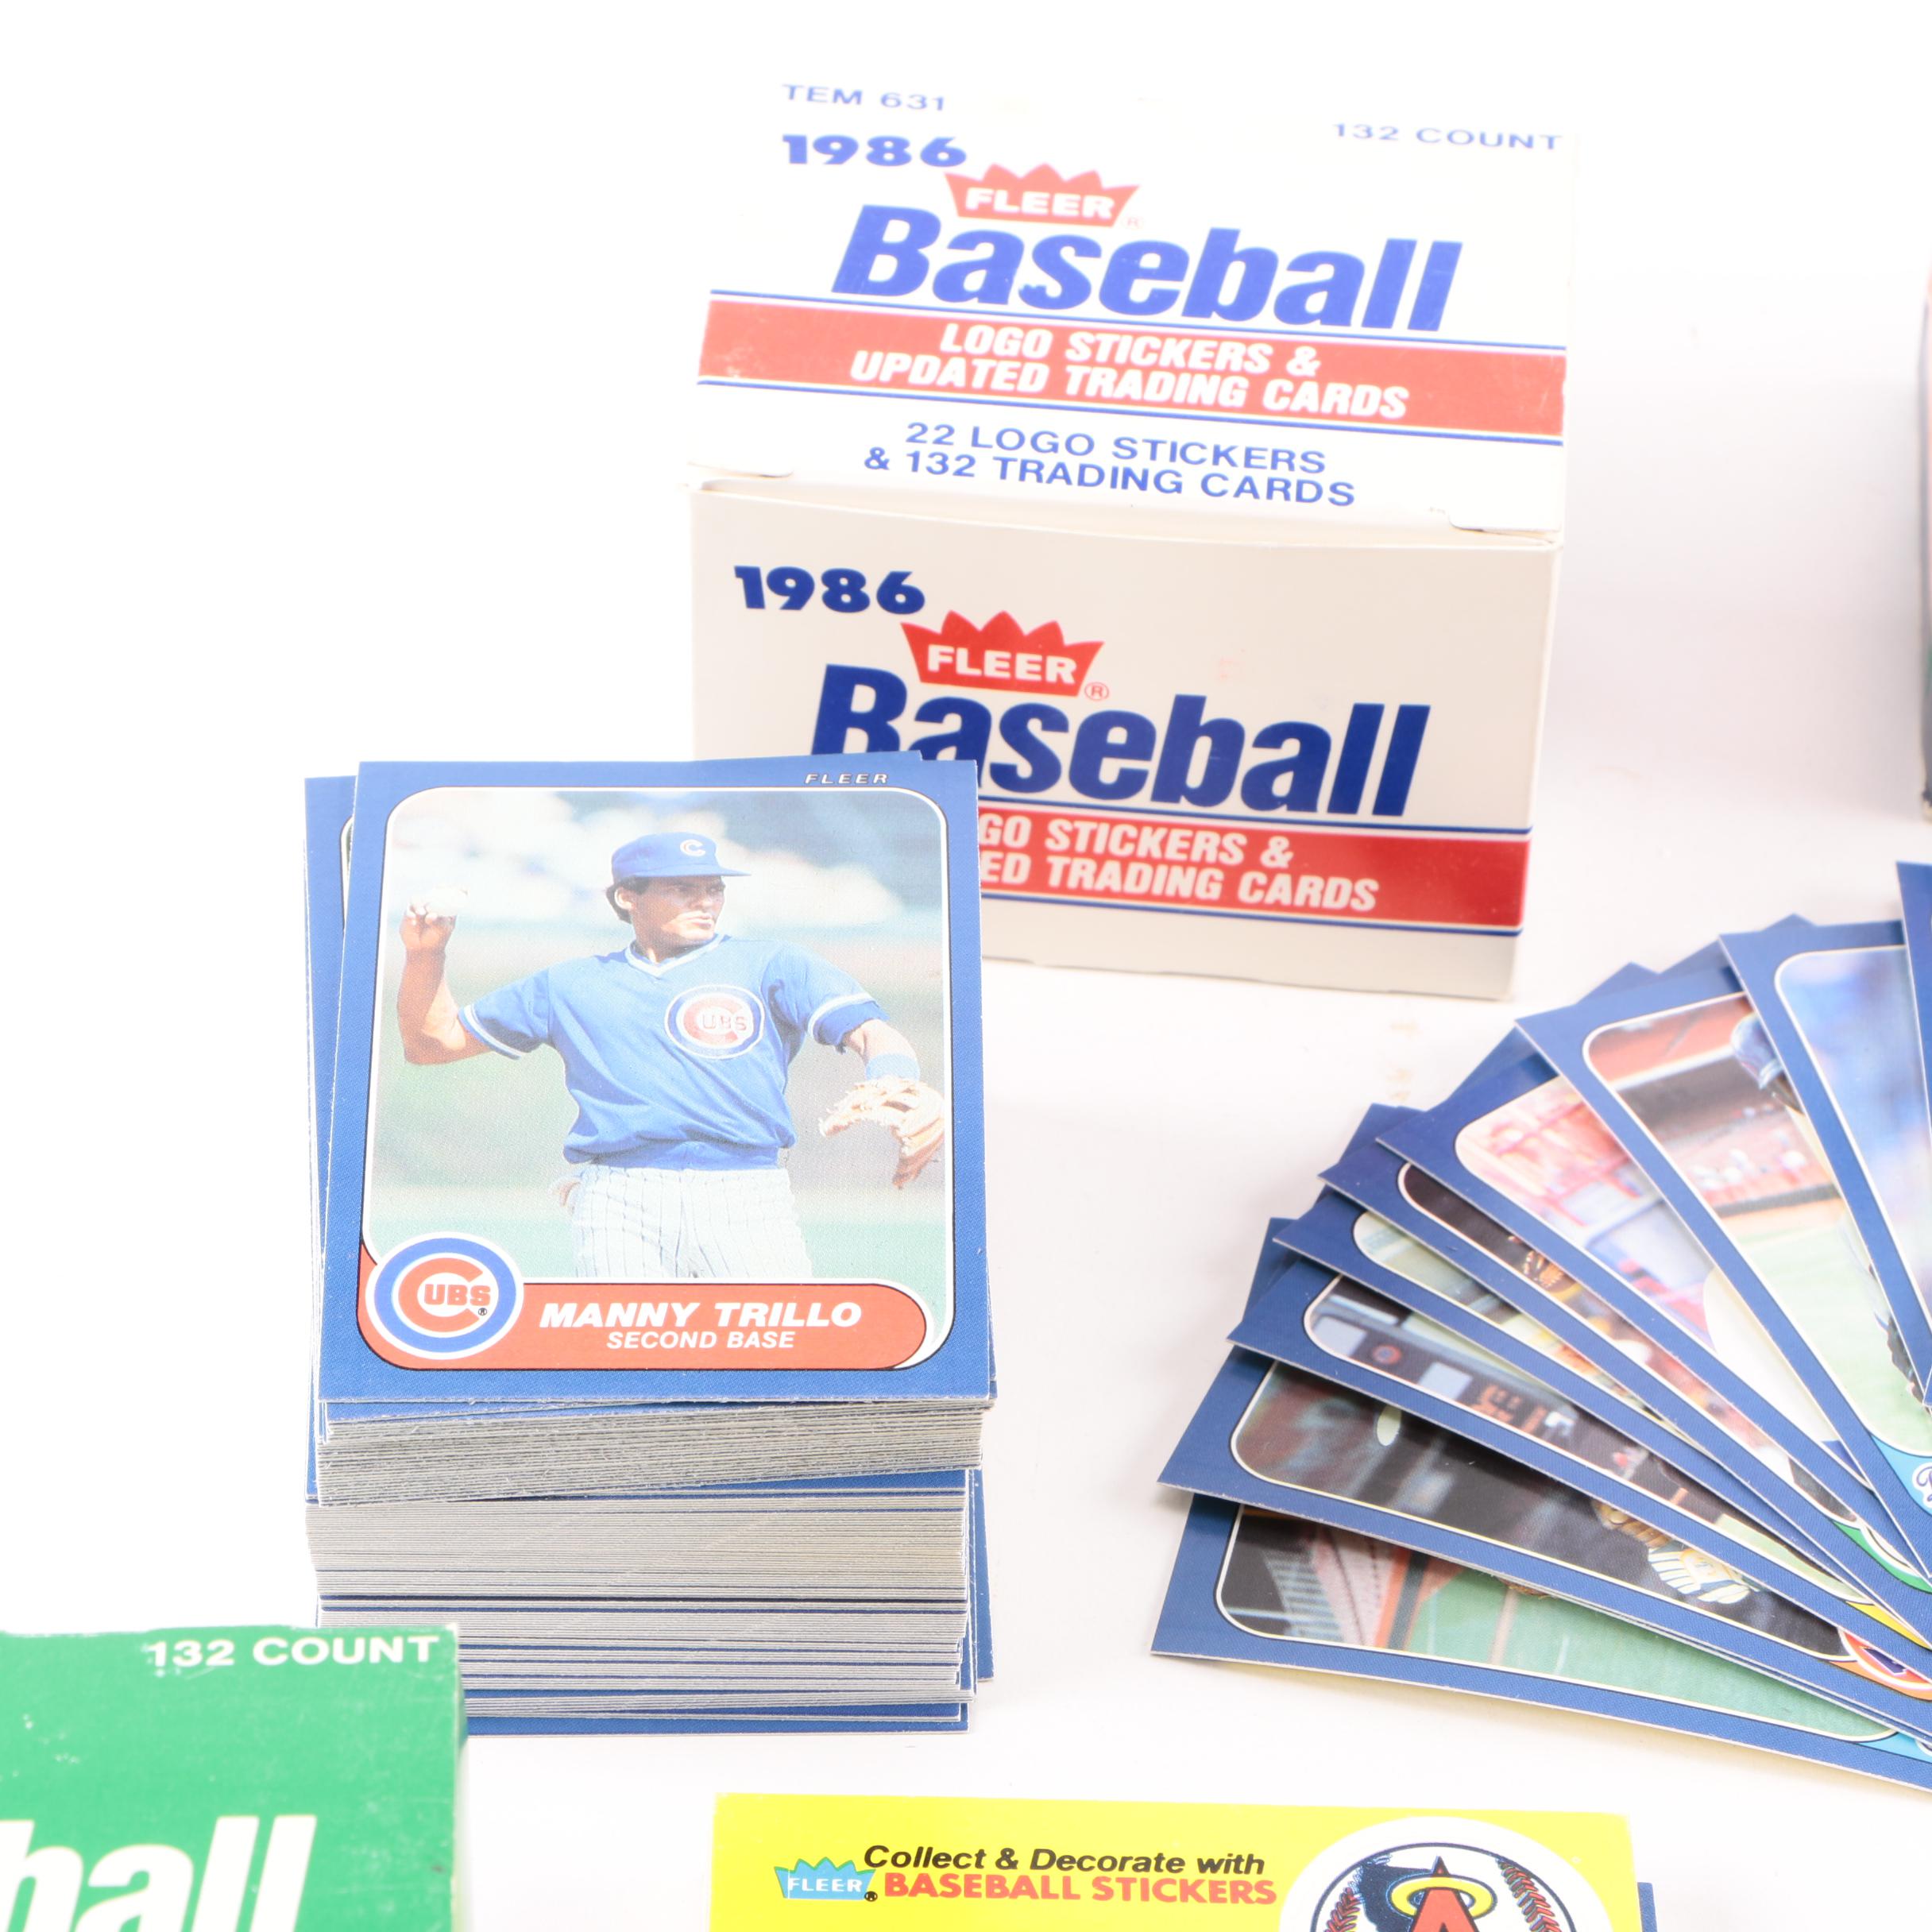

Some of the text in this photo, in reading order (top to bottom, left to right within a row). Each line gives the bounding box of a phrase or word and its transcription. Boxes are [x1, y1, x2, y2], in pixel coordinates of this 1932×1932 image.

[879, 91, 945, 111] 631
[782, 135, 967, 167] 1986
[1333, 123, 1563, 150] 132 COUNT
[965, 187, 1115, 219] FLEER
[831, 204, 1463, 332] Baseball
[940, 323, 1321, 377] LOGO STICKERS &
[850, 350, 1409, 419] UPDATED TRADING CARDS
[906, 422, 1326, 473] 22 LOGO STICKERS
[864, 446, 1355, 506] & 132 TRADING CARDS
[734, 565, 925, 615] 1986
[927, 644, 1078, 685] FLEER
[811, 663, 1431, 817] Baseball
[805, 773, 889, 784] FLEER
[978, 813, 1293, 867] GO STICKERS &
[1046, 855, 1223, 901] TRADING
[1237, 871, 1379, 912] CARDS
[539, 1303, 861, 1328] MANNY TRILLO
[607, 1331, 796, 1350] SECOND BASE
[147, 1636, 439, 1667] 132 COUNT
[0, 1814, 317, 1932] ball
[864, 1845, 1265, 1874] Collect & Decorate with
[788, 1877, 863, 1892] FLEER
[884, 1872, 1277, 1905] BASEBALL STICKERS
